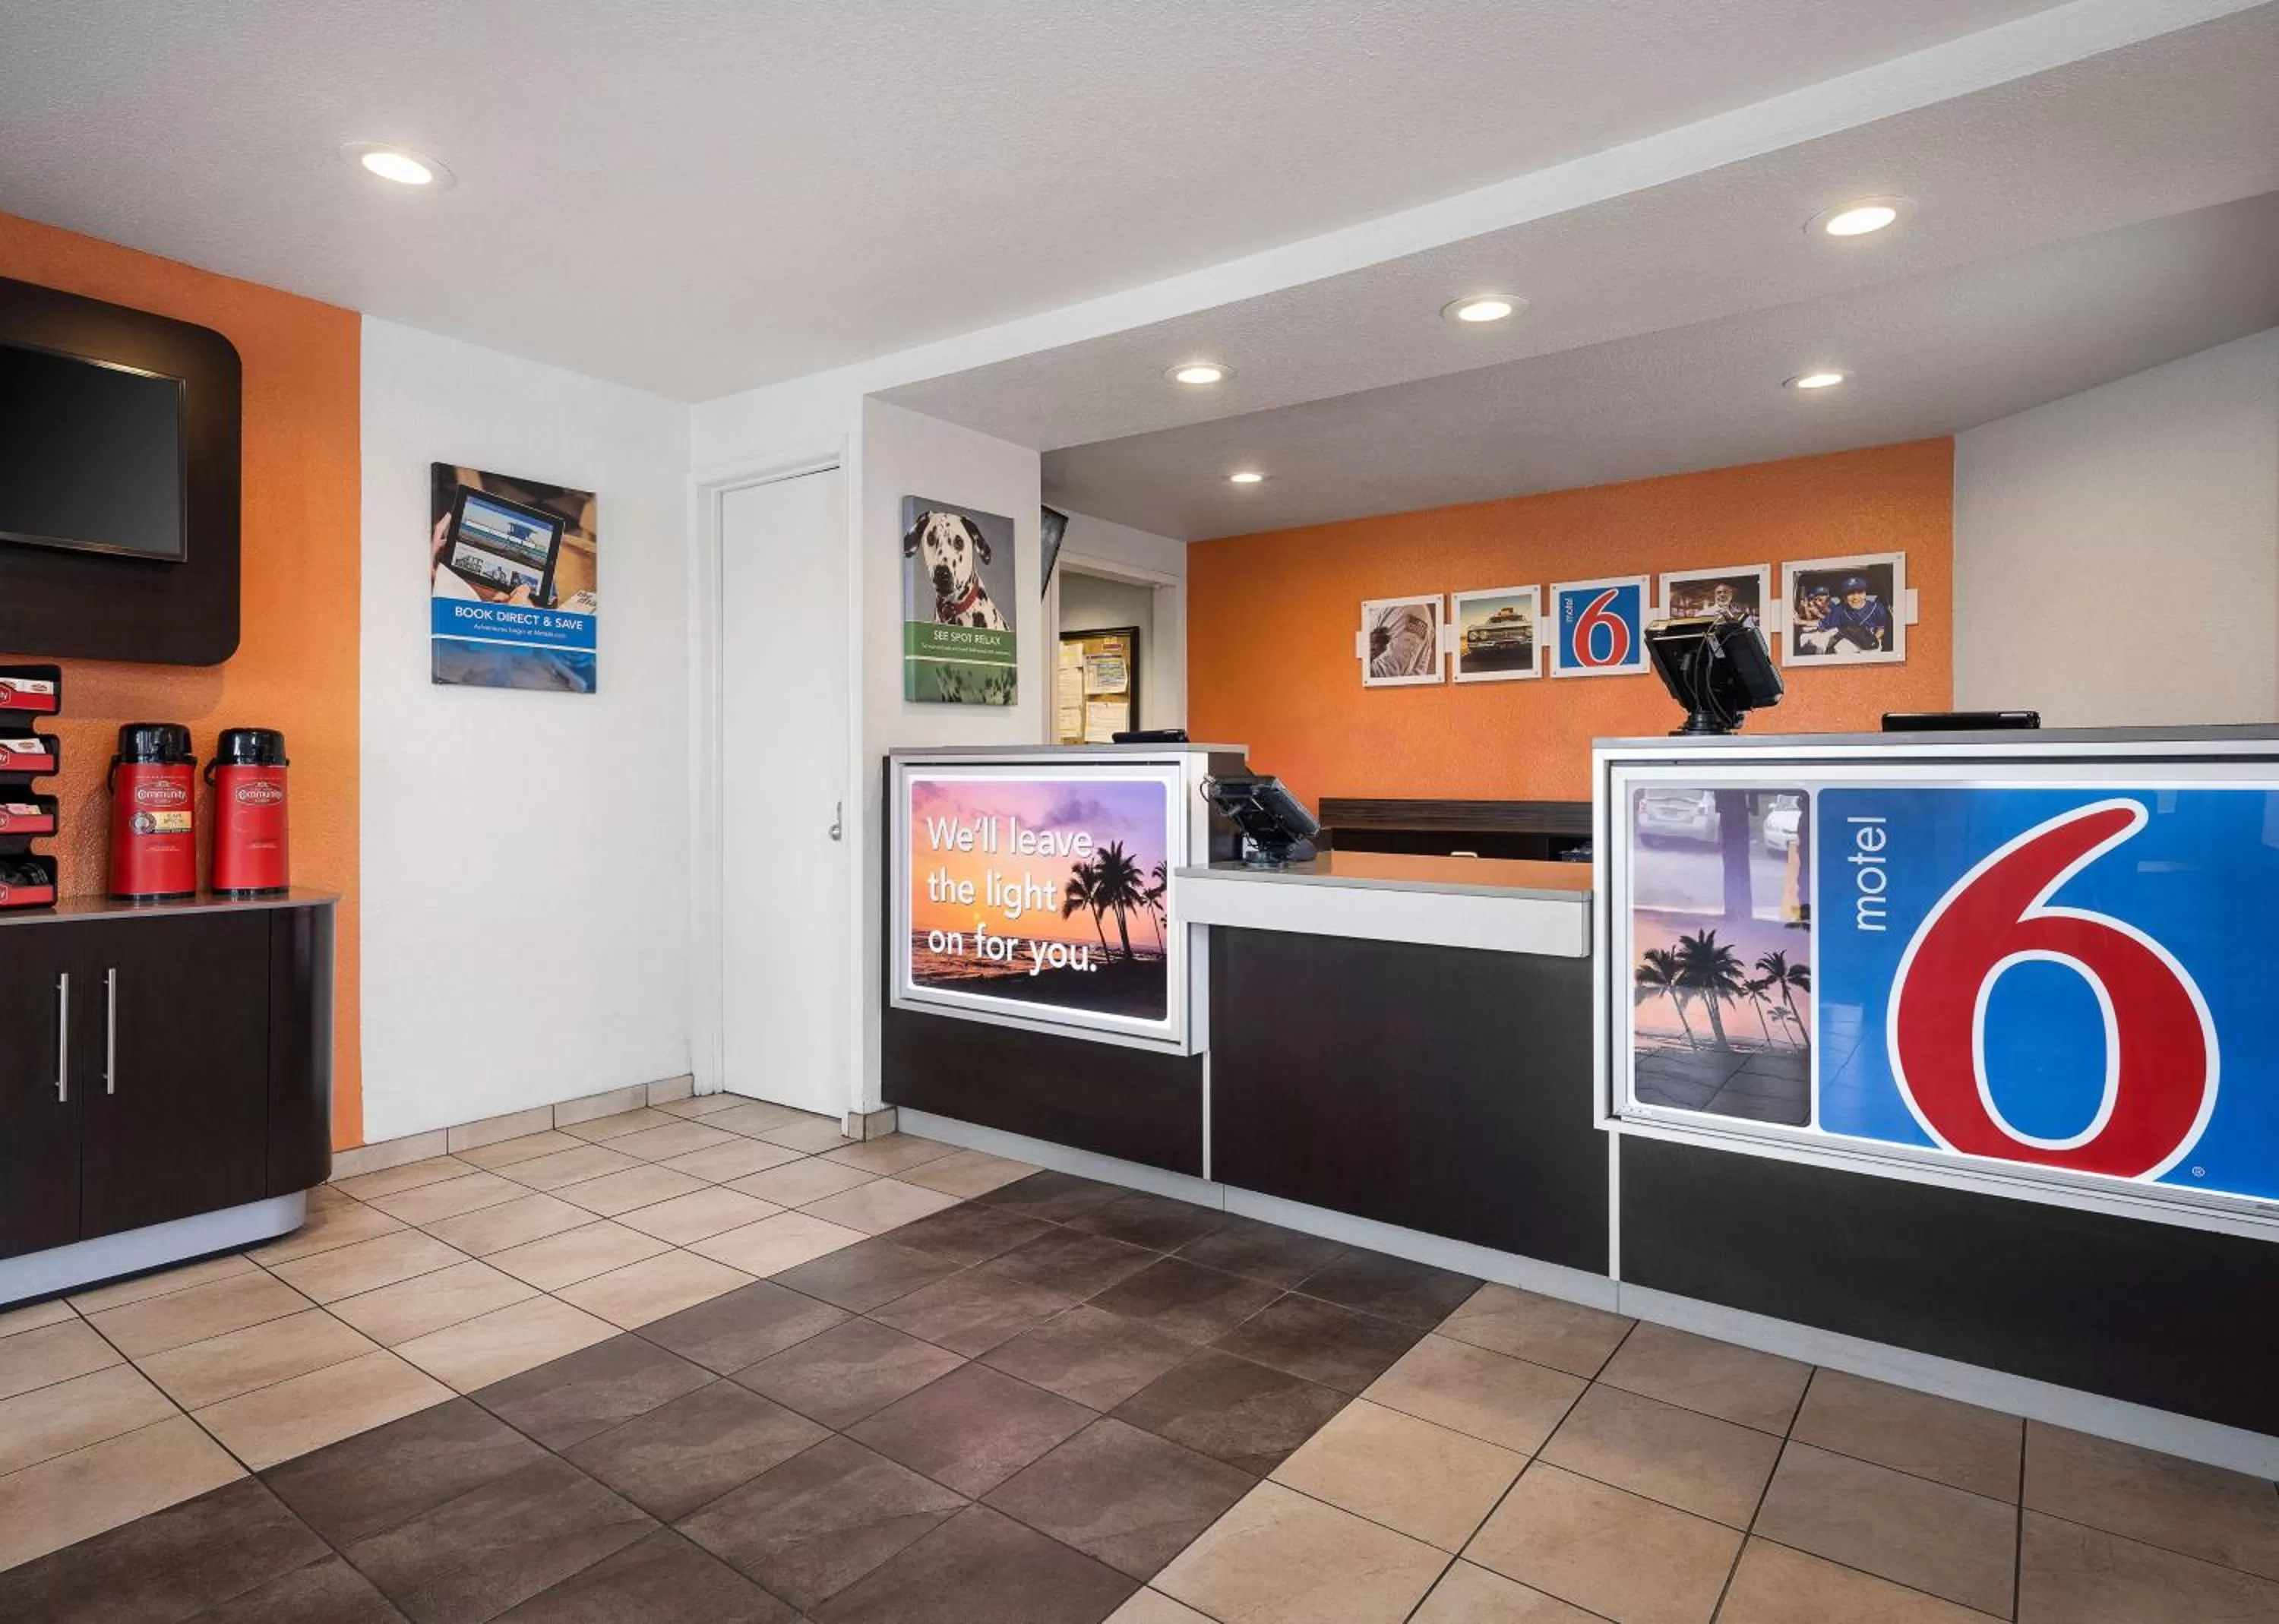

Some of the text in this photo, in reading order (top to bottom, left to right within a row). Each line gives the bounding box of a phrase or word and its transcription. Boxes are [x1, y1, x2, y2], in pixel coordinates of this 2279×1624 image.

[455, 606, 583, 630] BOOK DIRECT & SAVE
[934, 630, 1000, 646] SEE SPOT RELAX
[1572, 589, 1630, 667] 6
[1010, 817, 1093, 858] leave
[928, 867, 1057, 919] the light
[928, 923, 1097, 977] on for you.
[1848, 798, 2221, 1183] motel 6
